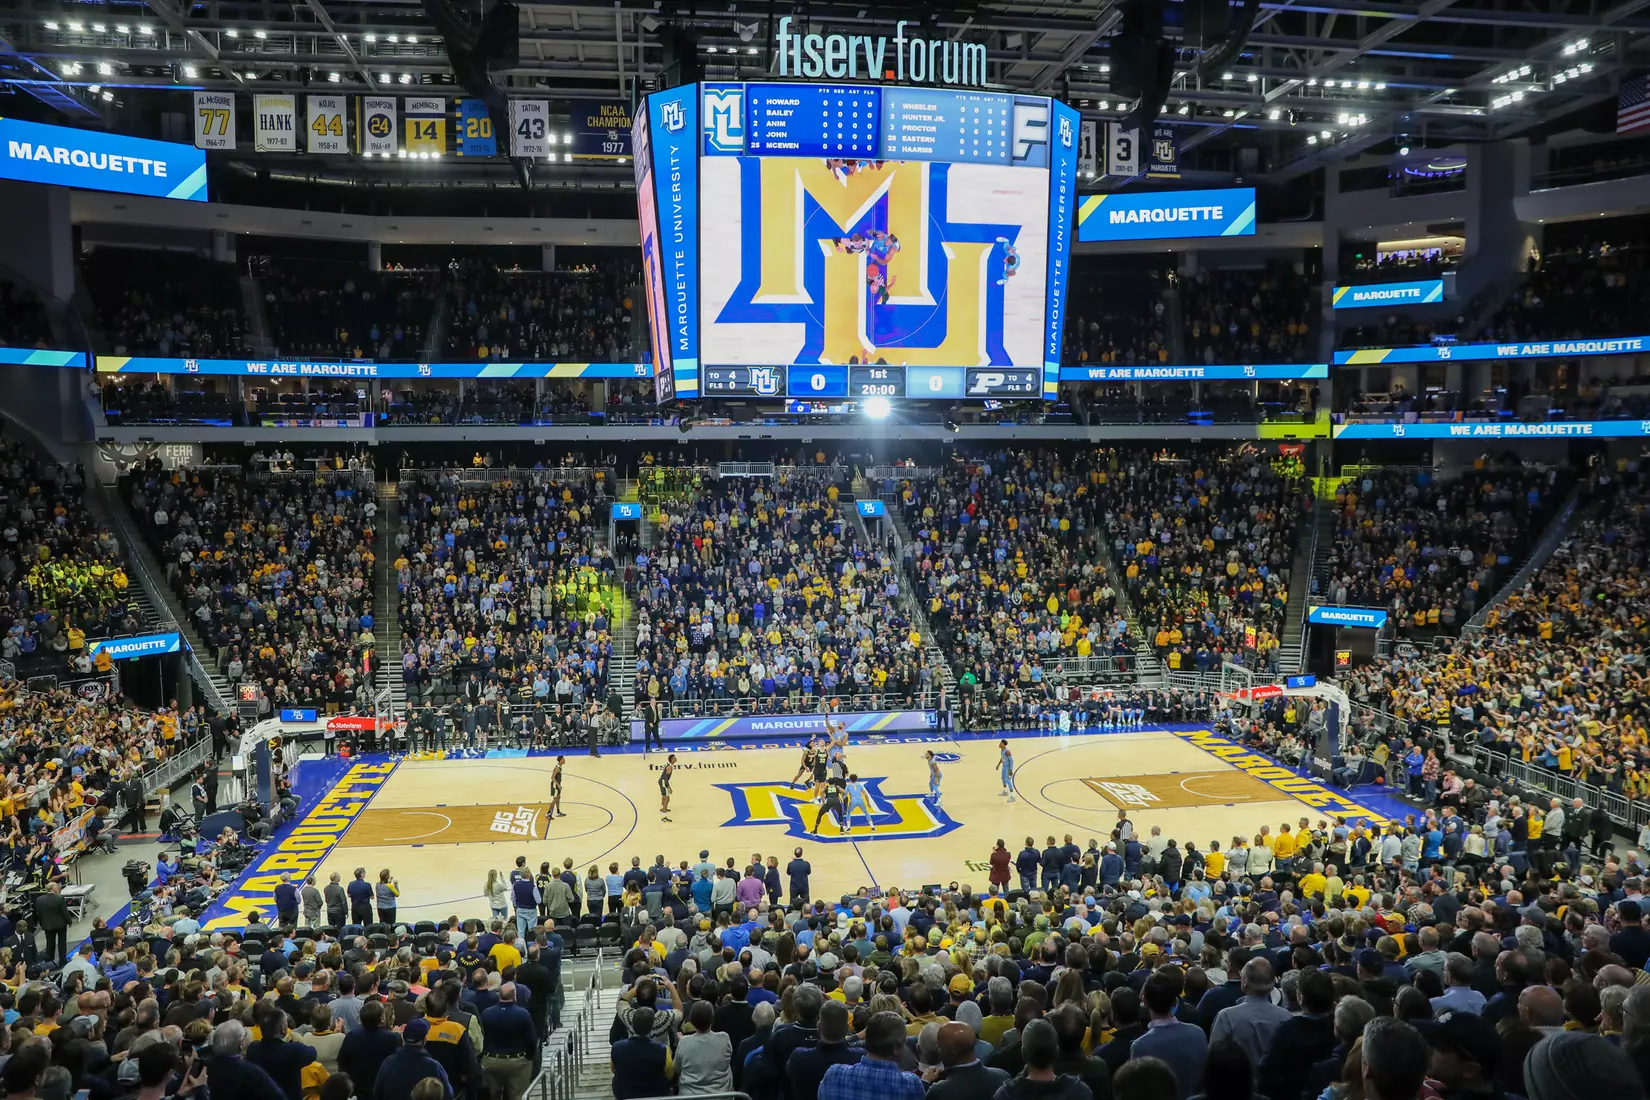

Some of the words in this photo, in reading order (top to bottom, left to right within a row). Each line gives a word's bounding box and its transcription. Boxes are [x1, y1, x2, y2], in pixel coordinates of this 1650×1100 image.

[198, 98, 206, 106] AL
[366, 101, 393, 110] THOMPSON
[412, 102, 439, 110] MEMINGER
[600, 106, 625, 116] NCAA
[660, 100, 686, 133] MU
[200, 108, 230, 135] 77
[260, 114, 292, 130] HANK
[312, 114, 343, 136] 44
[371, 118, 389, 134] 24
[467, 118, 492, 138] 20
[587, 117, 632, 127] CHAMPION
[414, 121, 437, 140] 14
[518, 118, 545, 139] 43
[602, 142, 624, 152] 1977
[1117, 138, 1132, 161] 3
[1152, 140, 1176, 162] MU
[8, 140, 167, 178] MARQUETTE
[670, 145, 684, 243] UNIVERSITY
[1109, 206, 1223, 224] MARQUETTE
[1050, 259, 1062, 354] MARQUETTE
[1056, 158, 1067, 251] UNIVERSITY
[675, 251, 688, 350] MARQUETTE
[1353, 288, 1420, 301] MARQUETTE
[1438, 347, 1451, 359] MU
[1497, 346, 1518, 356] WE
[1521, 344, 1549, 355] ARE
[1553, 340, 1641, 354] MARQUETTE
[184, 358, 199, 373] MU
[247, 363, 267, 372] WE
[271, 364, 297, 374] ARE
[301, 364, 377, 375] MARQUETTE
[418, 363, 432, 376] MU
[634, 364, 648, 376] MU
[1243, 366, 1256, 377] MU
[729, 371, 736, 379] 4
[869, 369, 887, 378] 1st
[1026, 373, 1032, 381] 4
[1088, 369, 1106, 378] WE
[1109, 369, 1131, 378] ARE
[1134, 368, 1204, 378] MARQUETTE
[747, 367, 780, 396] MU
[811, 374, 826, 390] 0
[929, 376, 943, 392] 0
[969, 373, 1005, 393] P
[862, 385, 895, 394] 20:00
[1393, 424, 1406, 436] MU
[1450, 425, 1470, 435] WE
[1474, 425, 1500, 434] ARE
[1505, 424, 1592, 434] MARQUETTE
[166, 445, 193, 456] FEAR
[620, 506, 632, 517] MU
[864, 502, 876, 514] MU
[1321, 612, 1374, 622] MARQUETTE
[106, 640, 166, 654] MARQUETTE
[1246, 636, 1255, 648] 30
[293, 711, 303, 720] MU
[751, 718, 838, 730] MARQUETTE
[1314, 757, 1332, 770] meijer
[490, 811, 514, 833] BIG
[510, 806, 534, 835] EAST
[201, 762, 397, 930] MARQUETTE
